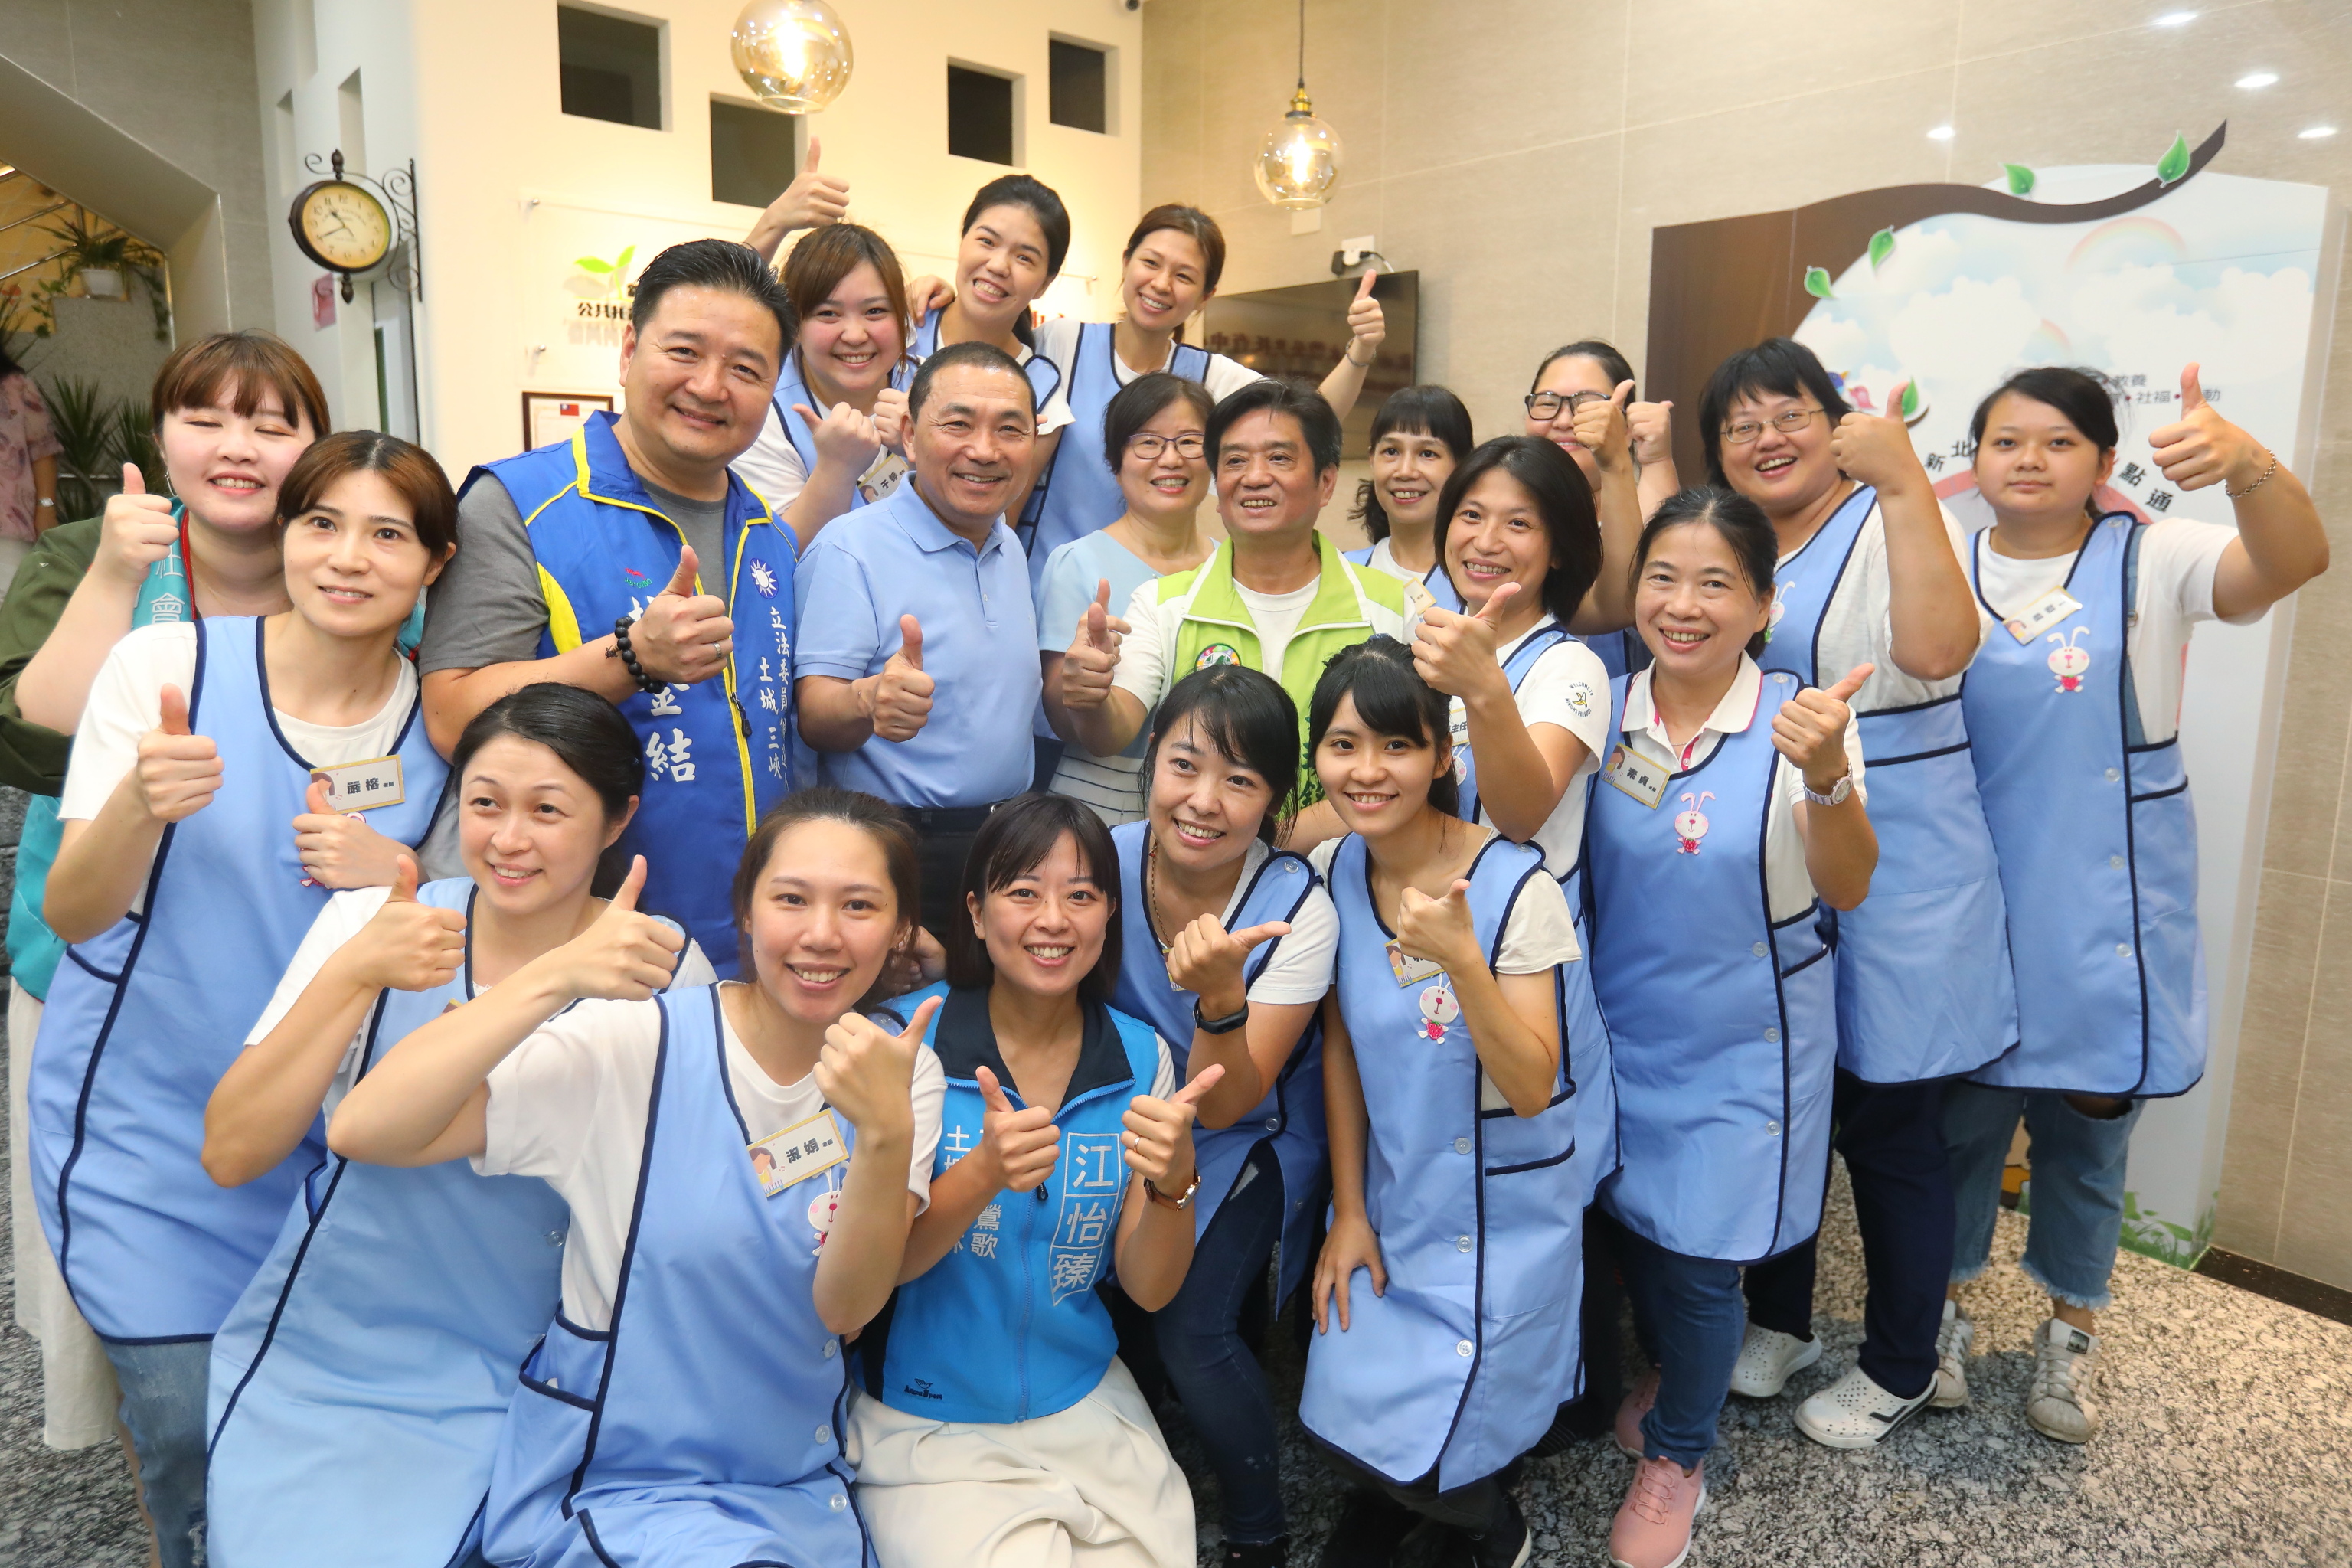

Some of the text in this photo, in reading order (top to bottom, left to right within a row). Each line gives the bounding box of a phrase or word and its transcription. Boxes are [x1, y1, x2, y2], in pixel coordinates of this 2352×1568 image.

[2137, 390, 2171, 404] 社福
[1569, 681, 1590, 691] WELCOME
[759, 656, 782, 779] 土城 三峽
[1451, 720, 1467, 733] 主任
[786, 1138, 820, 1164] 淑娟
[970, 1204, 1002, 1259] 鶯歌
[1052, 1143, 1114, 1294] 江怡臻
